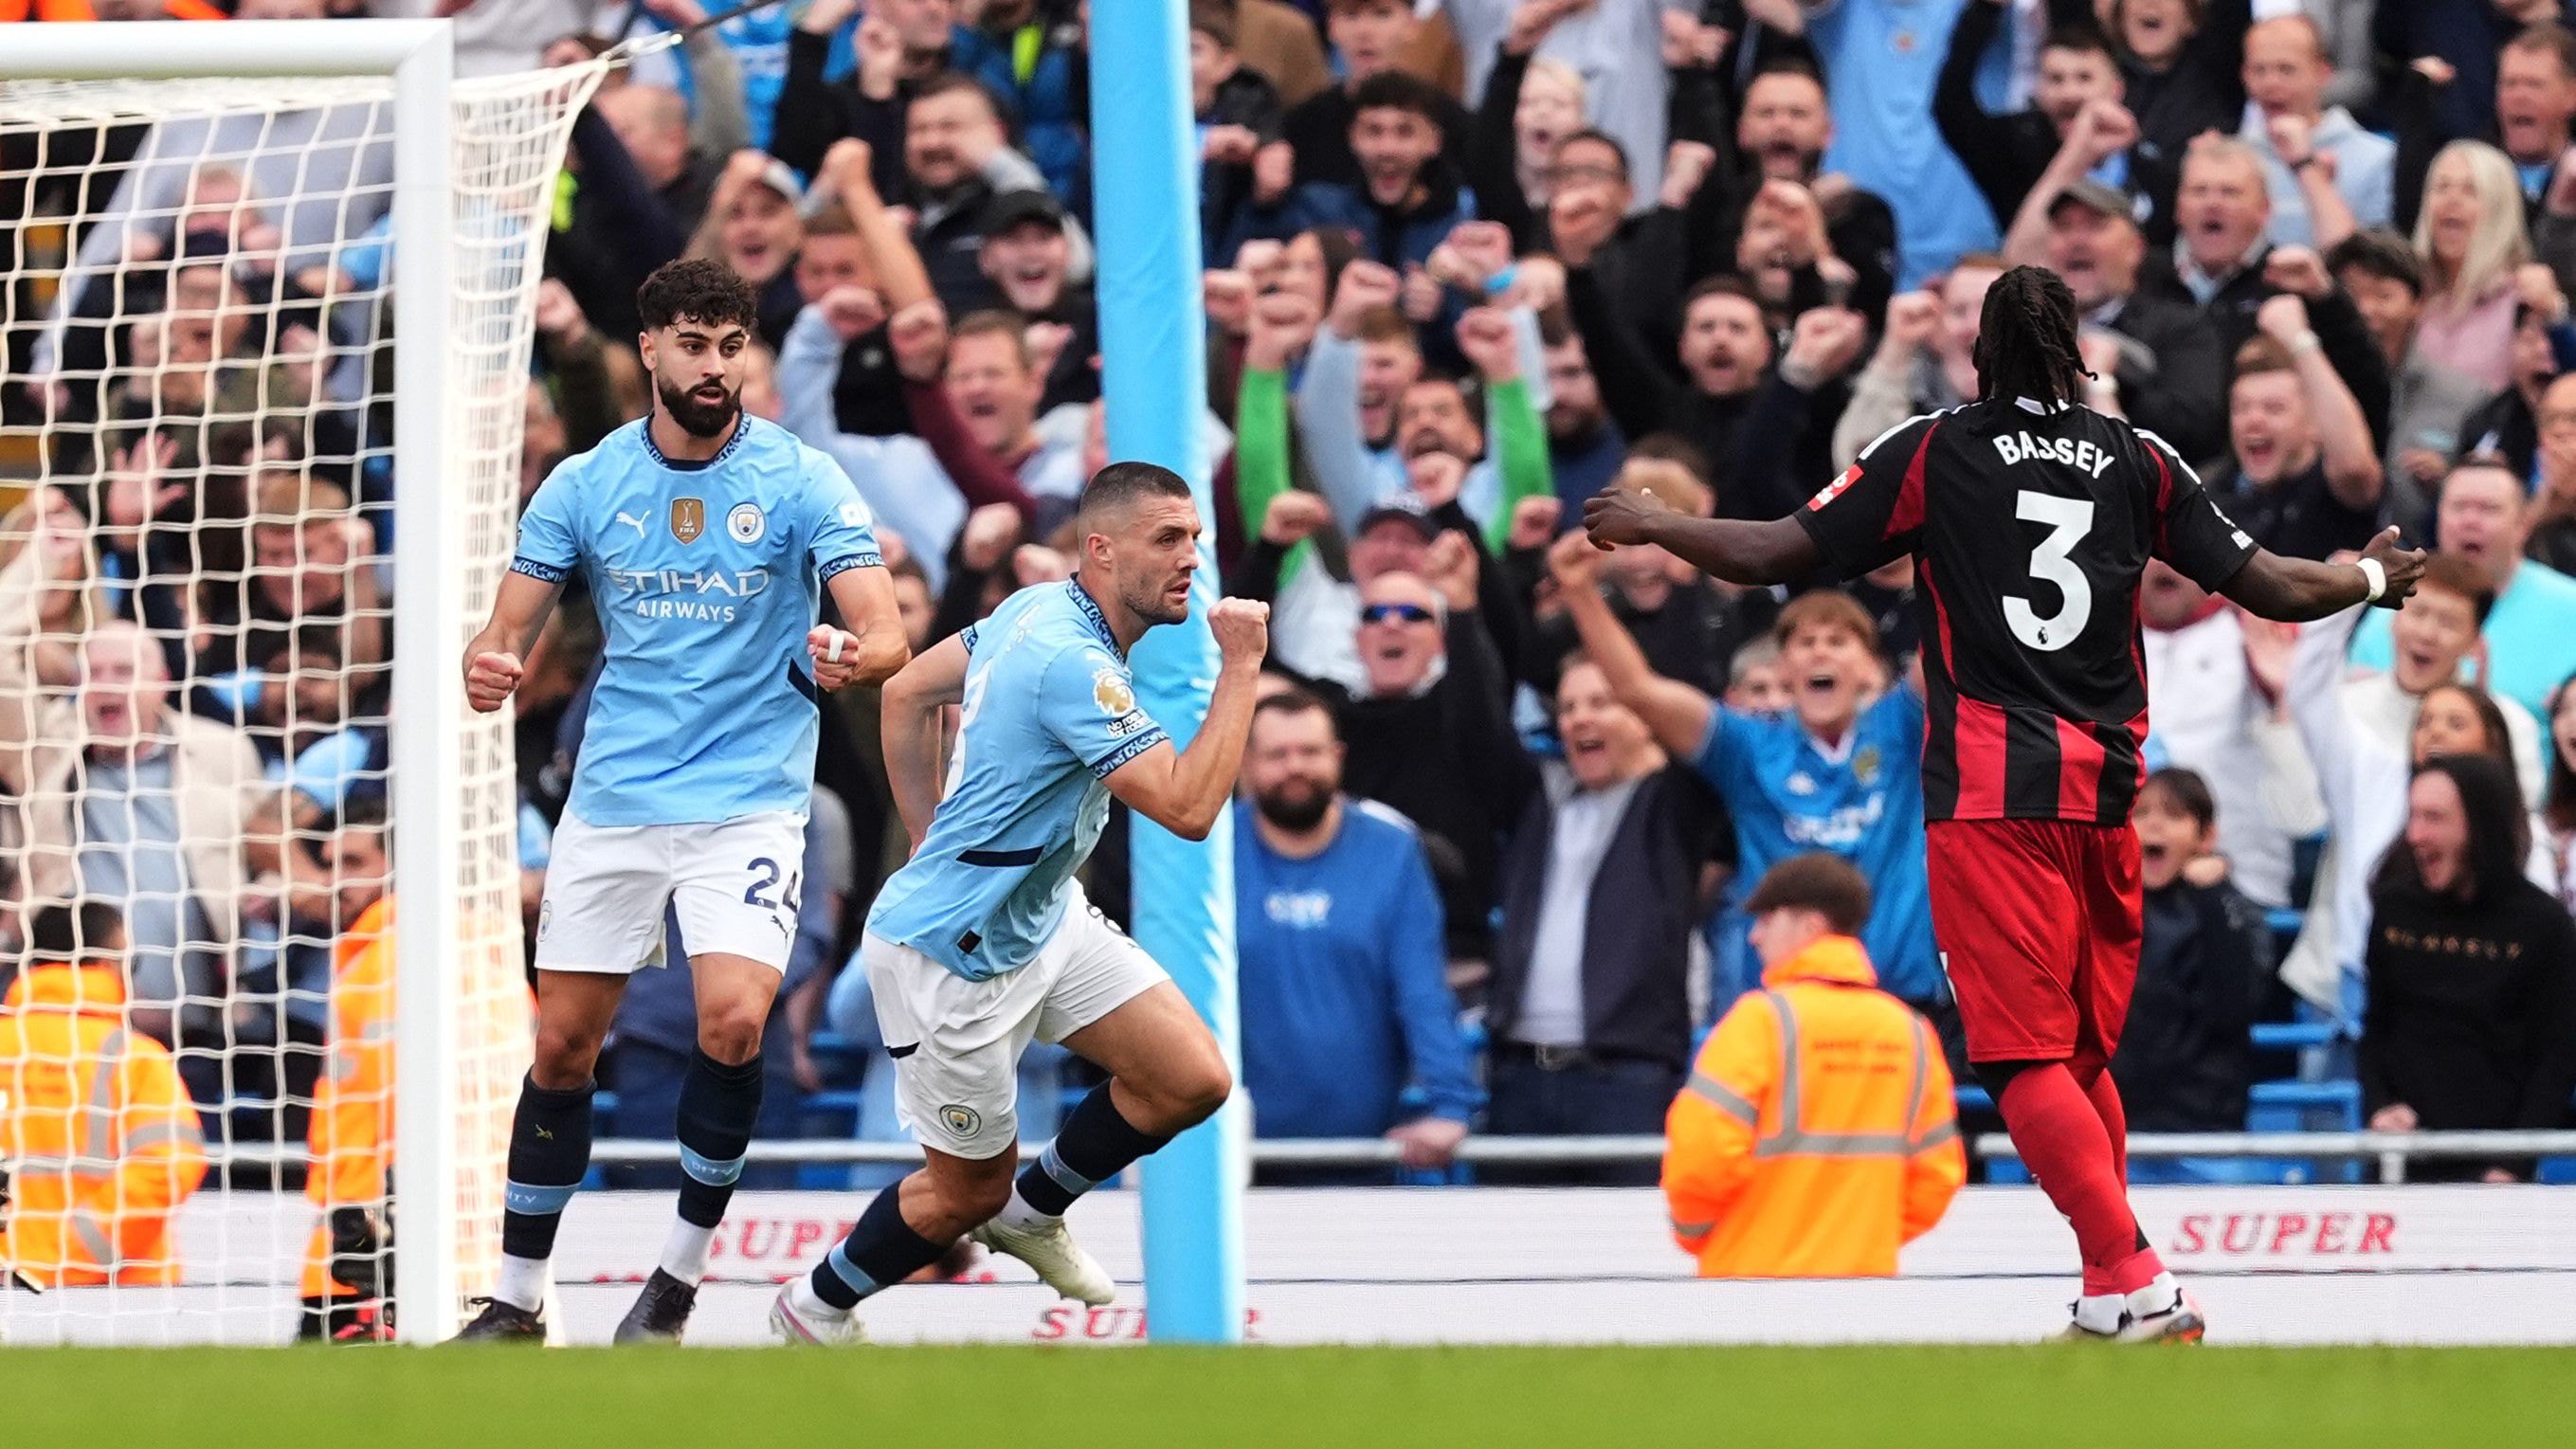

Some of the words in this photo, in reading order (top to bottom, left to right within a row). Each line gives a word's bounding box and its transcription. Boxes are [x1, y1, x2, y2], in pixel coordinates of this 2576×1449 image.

[1993, 430, 2114, 479] BASSEY
[604, 569, 770, 597] ETIHAD
[2002, 489, 2095, 651] 3
[636, 600, 735, 623] AIRWAYS
[506, 1191, 537, 1204] ITY
[2172, 1212, 2396, 1254] SUPER
